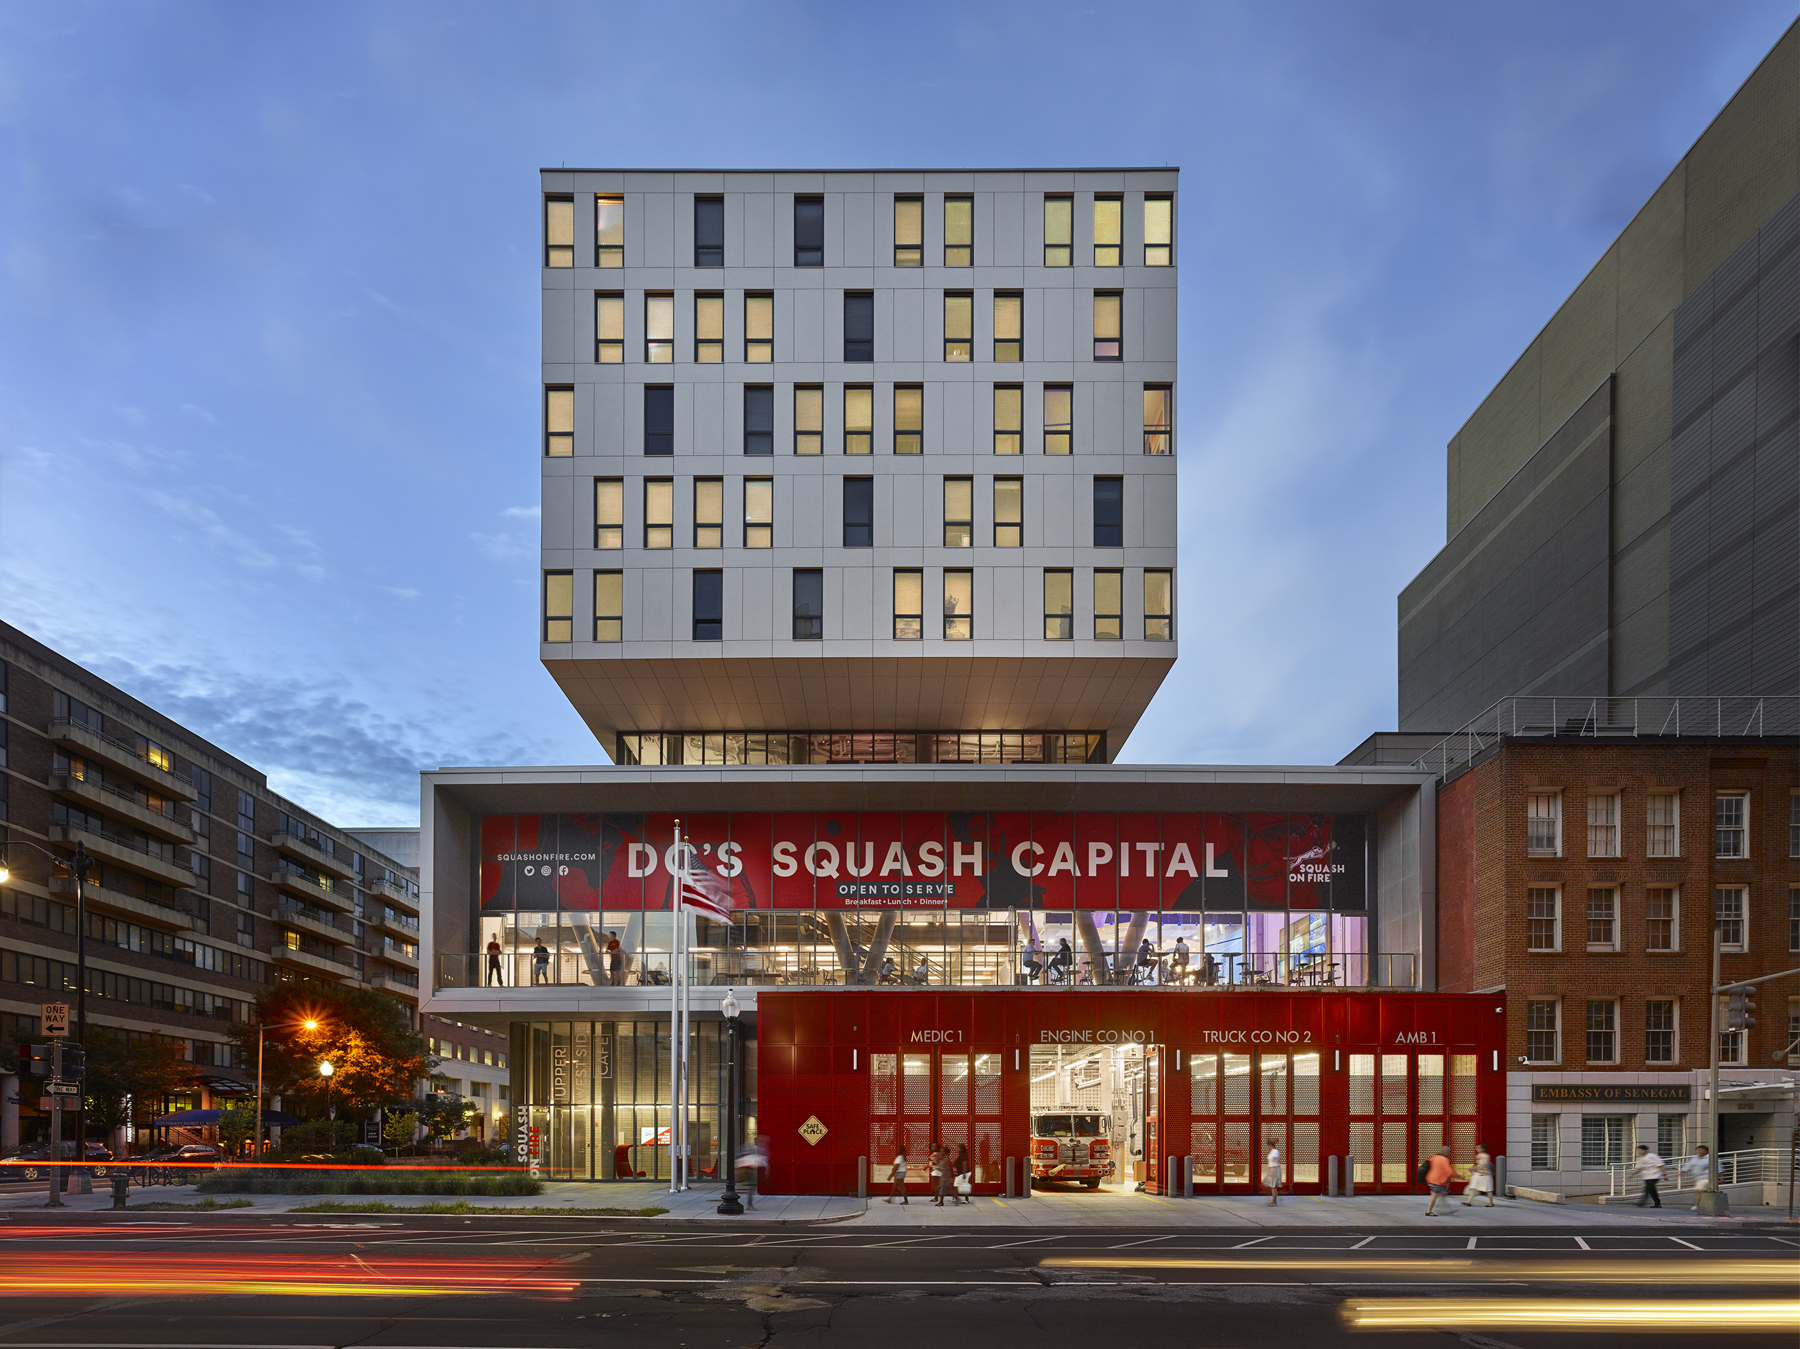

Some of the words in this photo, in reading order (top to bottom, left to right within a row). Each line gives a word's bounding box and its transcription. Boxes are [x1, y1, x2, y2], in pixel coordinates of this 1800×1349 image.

[497, 853, 596, 862] SQUASHONFIRE.COM
[773, 841, 983, 880] SQUASH
[1011, 840, 1229, 878] CAPITAL
[1300, 864, 1345, 873] SQUASH
[1289, 873, 1305, 882] ON
[1307, 874, 1331, 882] FIRE
[839, 885, 877, 894] OPEN
[882, 885, 900, 894] TO
[906, 884, 954, 894] SERVE
[845, 898, 882, 906] Breakfast
[887, 898, 912, 906] Lunch
[919, 898, 945, 906] Dinner
[46, 1006, 65, 1014] ONE
[45, 1015, 66, 1023] WAY
[575, 1024, 587, 1058] SIDE
[910, 1030, 954, 1043] MEDIC
[957, 1030, 962, 1043] 1
[1040, 1030, 1093, 1043] ENGINE
[1096, 1030, 1118, 1043] CO
[1121, 1030, 1146, 1043] NO
[1149, 1030, 1154, 1043] 1
[1203, 1030, 1247, 1043] TRUCK
[1251, 1030, 1273, 1043] CO
[1276, 1030, 1299, 1043] NO
[1303, 1030, 1312, 1043] 2
[1395, 1031, 1428, 1044] AMB
[1431, 1031, 1436, 1044] 1
[555, 1047, 567, 1097] UPPER
[575, 1060, 587, 1102] WEST
[1540, 1088, 1602, 1098] EMBASSY
[1604, 1088, 1622, 1098] OF
[1624, 1088, 1687, 1098] SENEGAL
[518, 1105, 528, 1163] SQUASH
[529, 1126, 540, 1155] FIRE
[529, 1158, 540, 1180] ON
